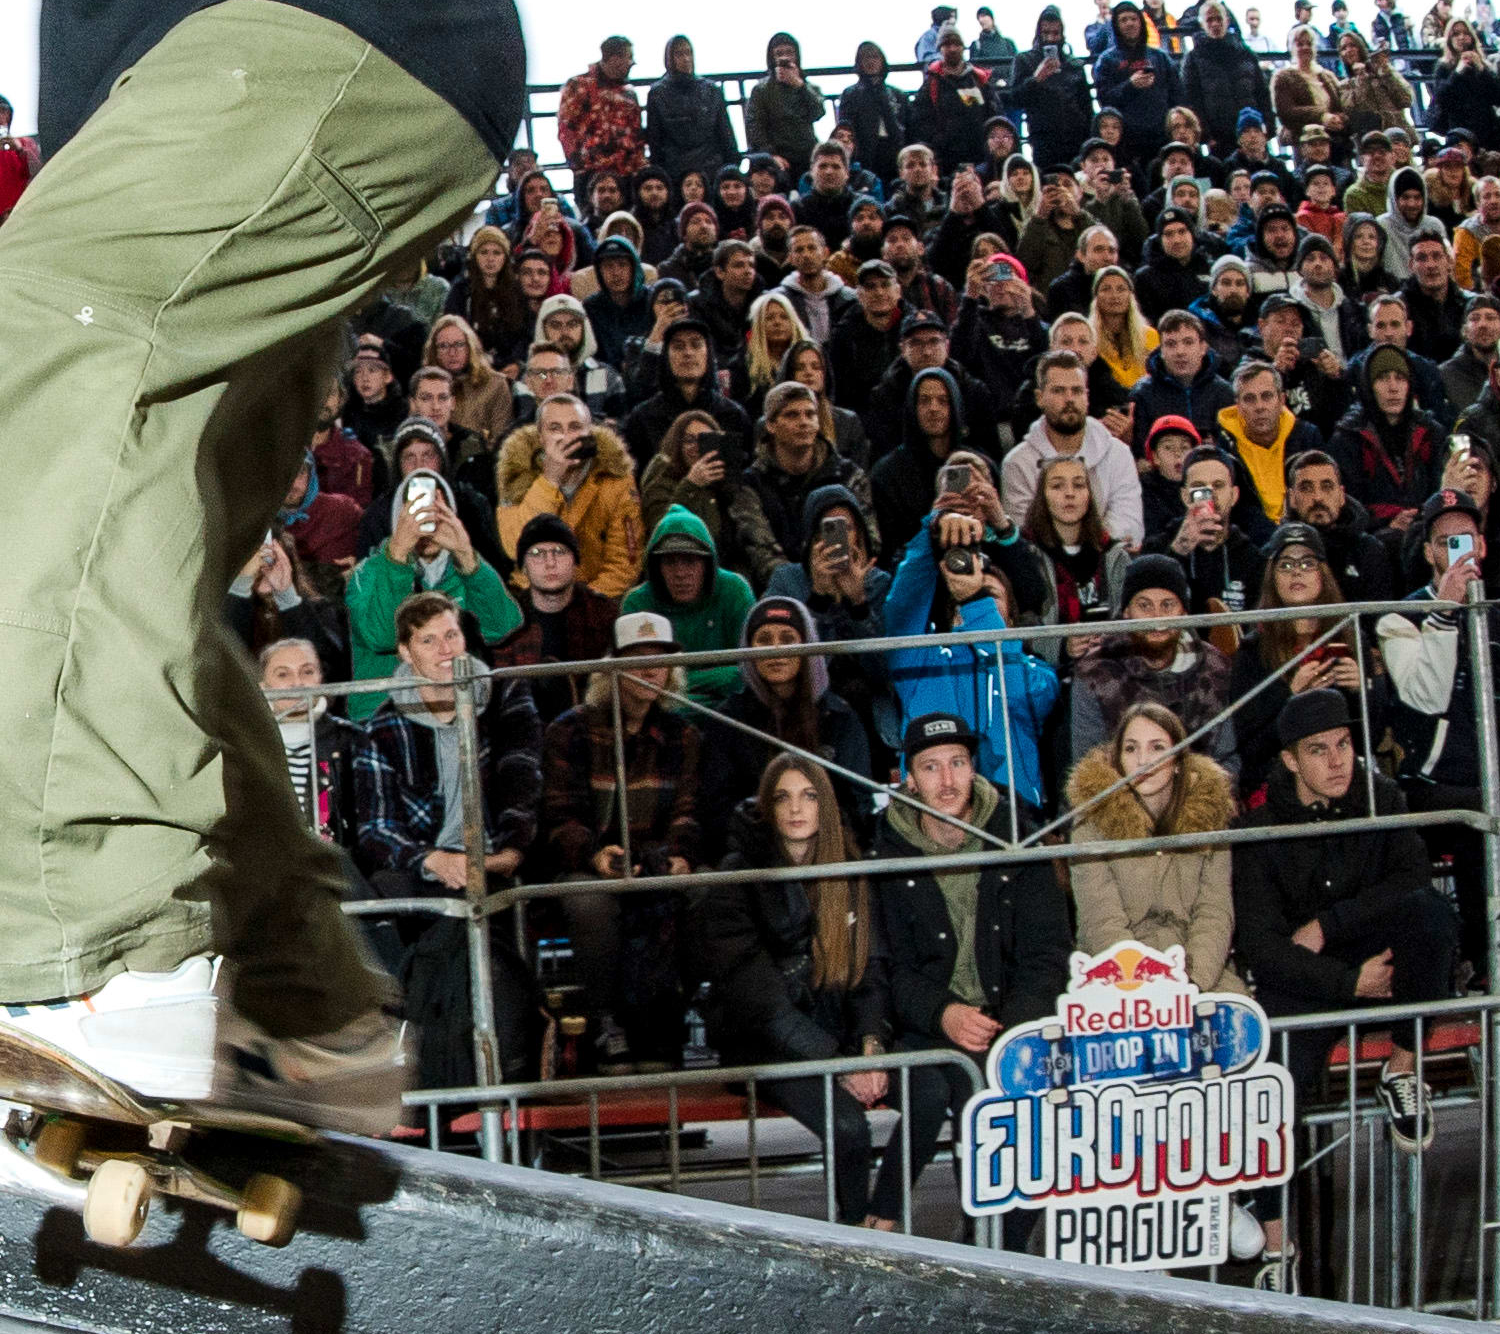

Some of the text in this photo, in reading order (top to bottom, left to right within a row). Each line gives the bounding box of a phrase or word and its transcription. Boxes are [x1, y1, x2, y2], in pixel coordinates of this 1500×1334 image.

[1067, 994, 1193, 1033] Red Bull
[1086, 1032, 1180, 1074] DROP IN
[973, 1076, 1288, 1204] EUROTOUR
[1055, 1197, 1204, 1265] PRAGUE
